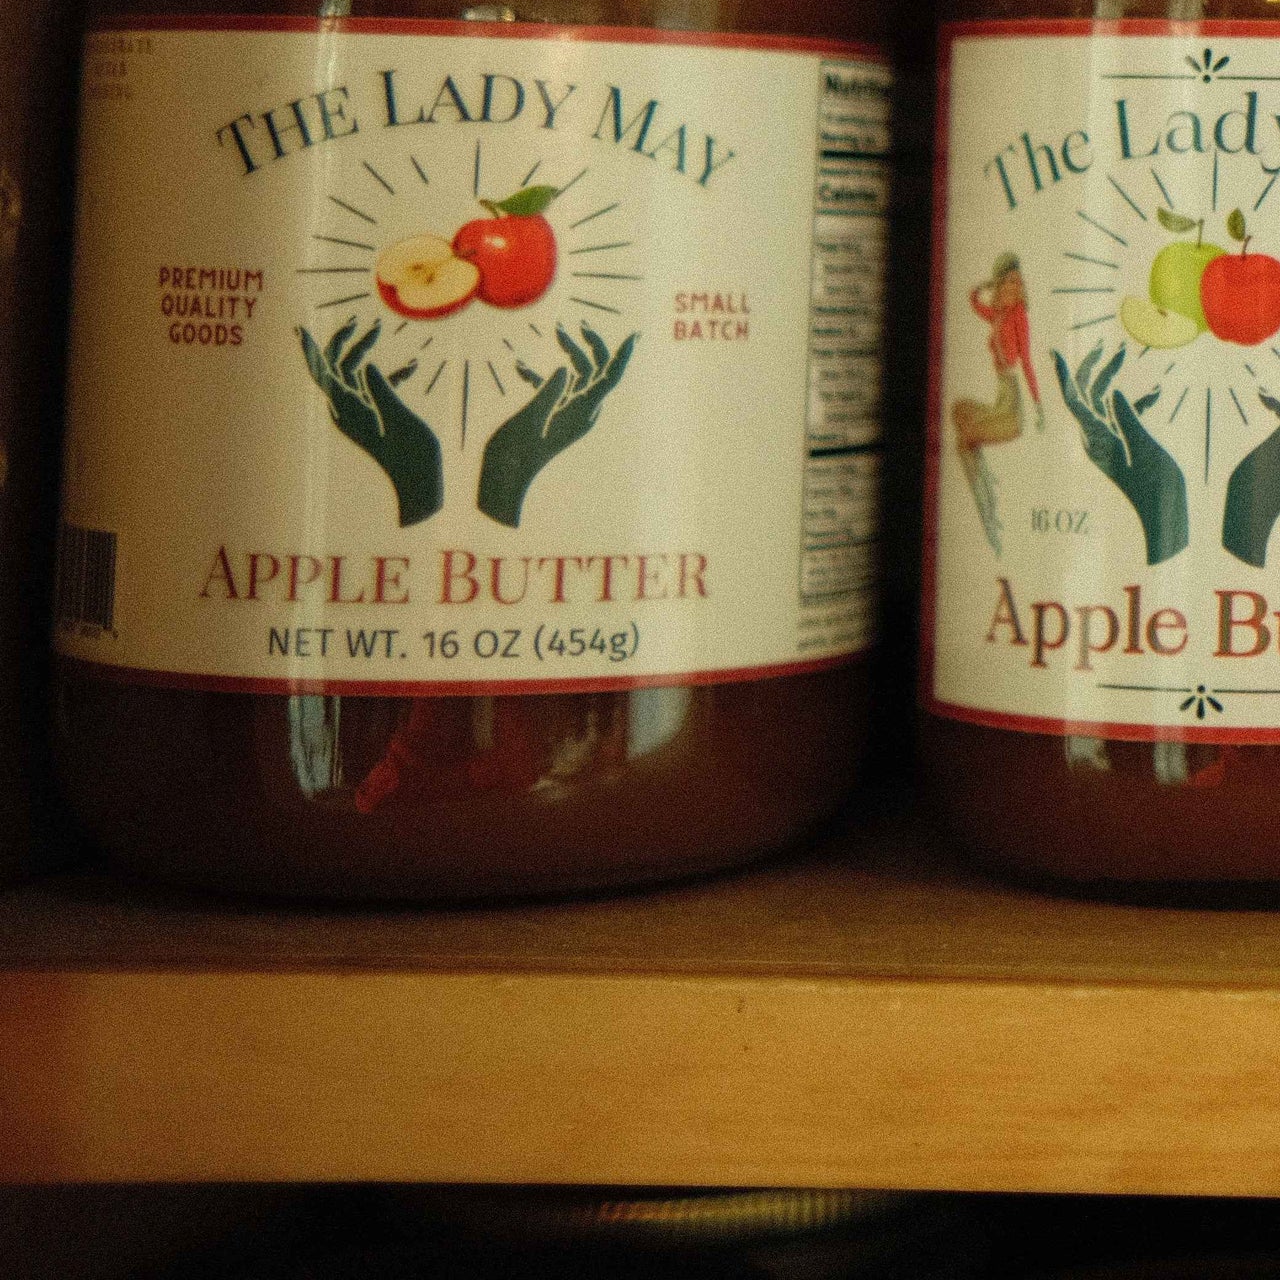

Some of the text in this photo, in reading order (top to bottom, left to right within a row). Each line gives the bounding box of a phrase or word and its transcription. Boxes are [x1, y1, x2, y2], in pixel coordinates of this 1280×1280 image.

[216, 68, 736, 192] THE LADY MAY
[983, 129, 1095, 211] The
[158, 267, 264, 293] PREMIUM
[160, 294, 257, 320] QUALITY
[673, 292, 751, 315] SMALL
[168, 321, 244, 346] GOODS
[673, 319, 750, 342] BATCH
[1031, 508, 1089, 534] 16 OZ
[199, 545, 711, 605] APPLE BUTTER
[985, 576, 1189, 669] Apple
[268, 624, 641, 663] NET WT. 16 OZ (454g)
